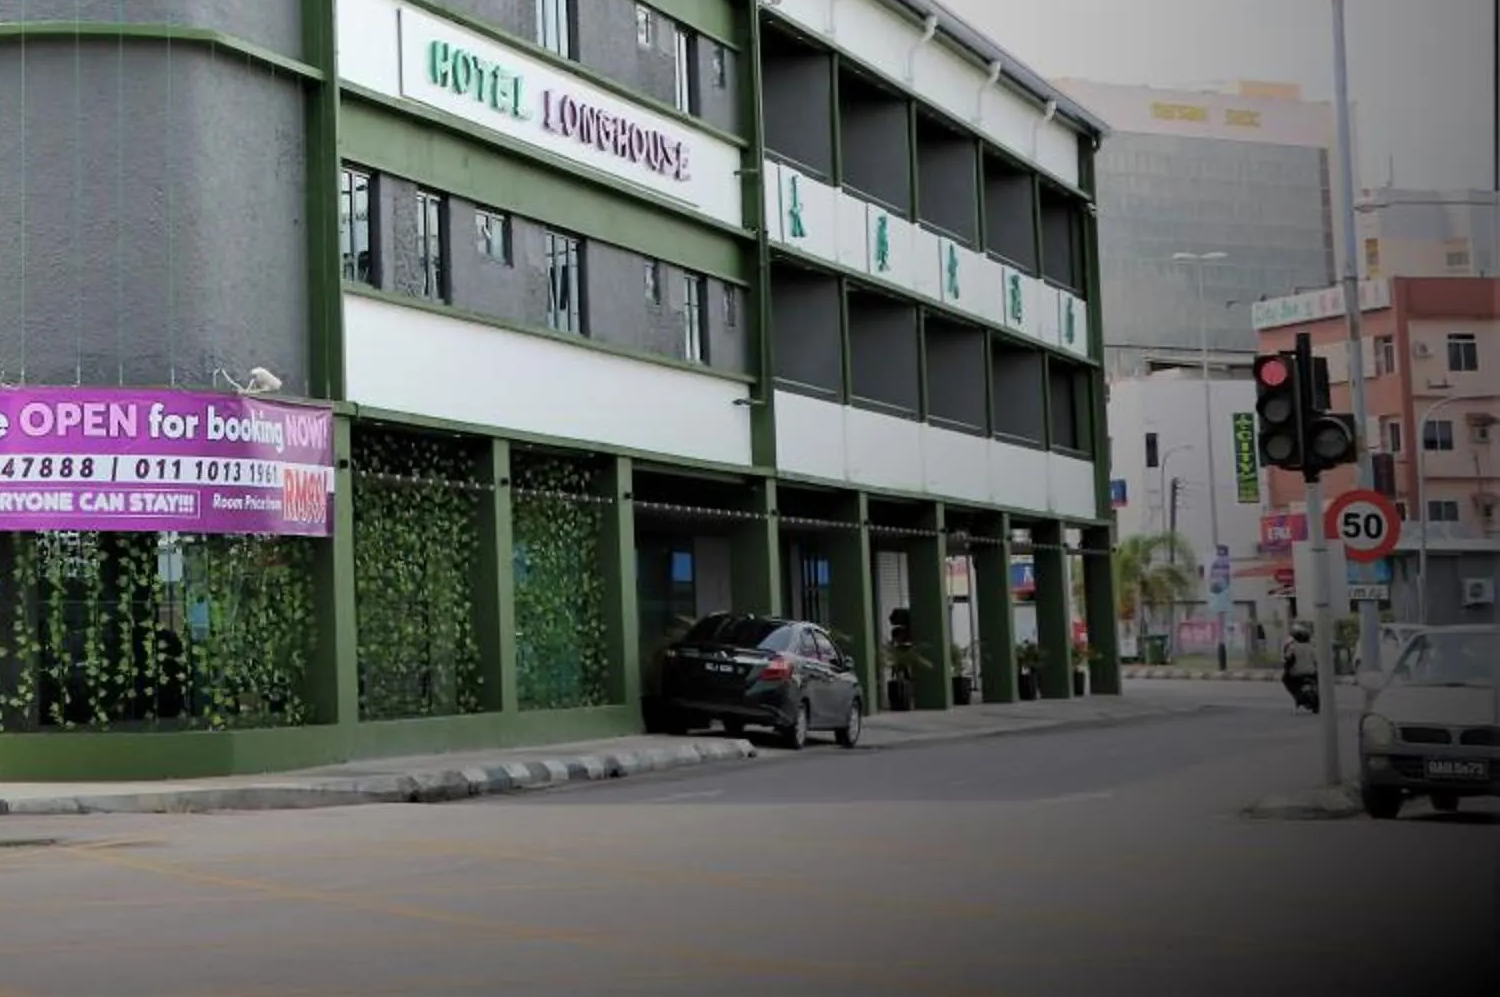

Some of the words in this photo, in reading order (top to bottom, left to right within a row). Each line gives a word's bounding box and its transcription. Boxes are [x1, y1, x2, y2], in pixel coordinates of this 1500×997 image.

[429, 40, 531, 120] HOTEL
[19, 402, 137, 437] OPEN
[149, 403, 199, 439] for
[206, 405, 284, 454] booking
[135, 459, 181, 480] 011
[195, 460, 241, 481] 1013
[79, 492, 124, 512] CAN
[1342, 512, 1384, 540] 50
